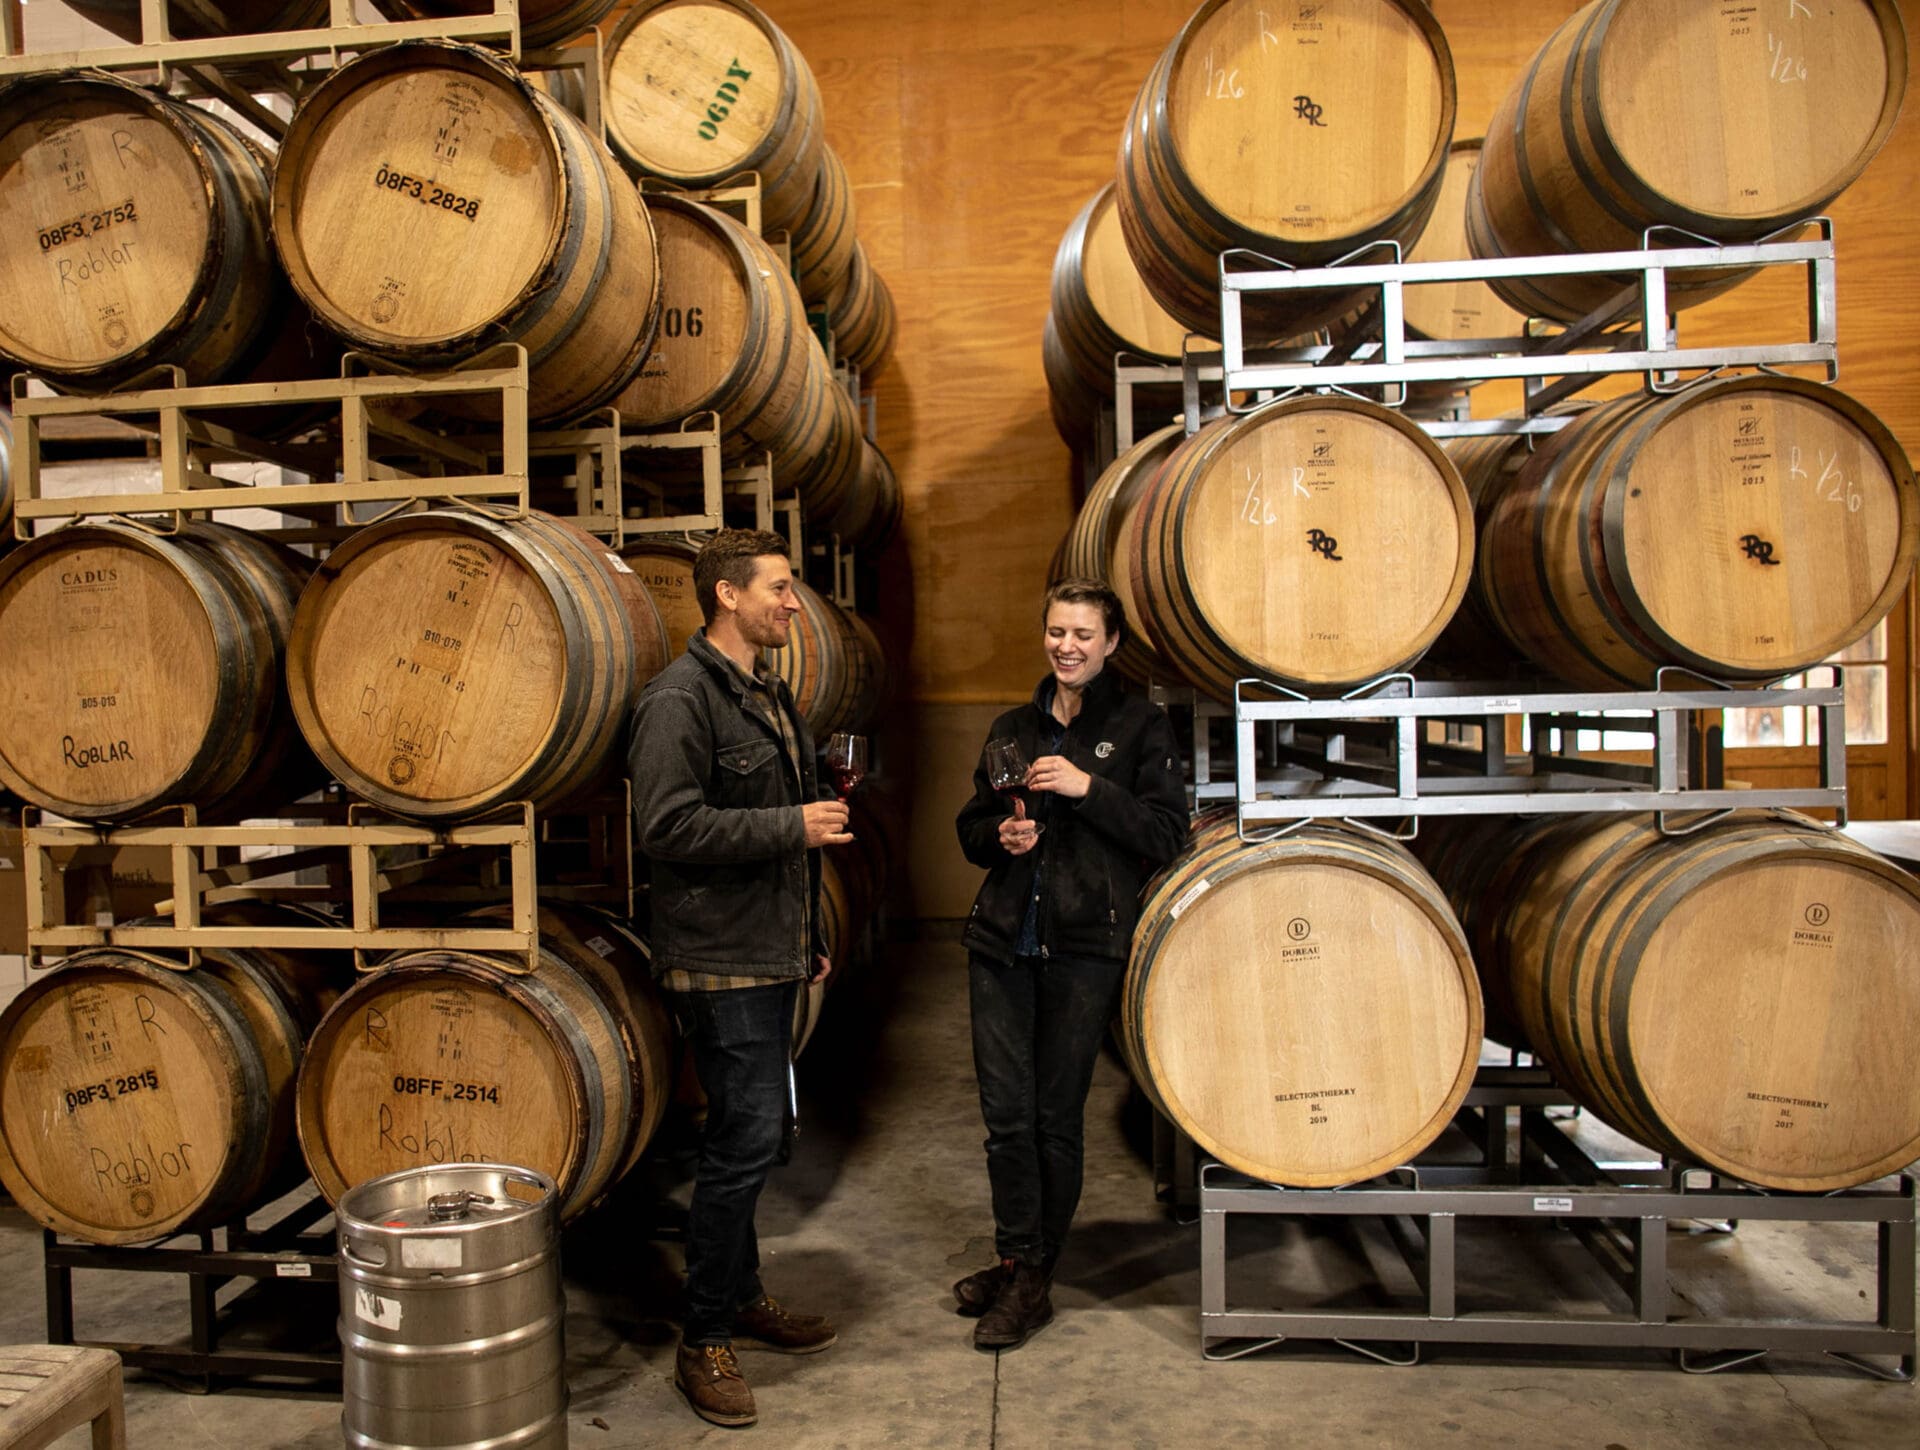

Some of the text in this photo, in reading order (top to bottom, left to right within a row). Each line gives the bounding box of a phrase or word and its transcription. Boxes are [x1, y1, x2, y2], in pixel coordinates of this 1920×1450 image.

[1256, 9, 1278, 54] R
[697, 57, 752, 141] OGDY
[112, 129, 141, 170] R
[1790, 446, 1807, 480] R
[1292, 467, 1310, 498] R
[61, 568, 118, 586] CADUS
[640, 575, 684, 587] ADUS
[497, 602, 523, 653] R
[1282, 946, 1320, 957] DOREAU
[1794, 931, 1834, 943] DOREAU
[135, 994, 167, 1042] R
[366, 1007, 389, 1049] R
[1310, 1116, 1328, 1125] 2019
[1774, 1120, 1794, 1130] 2017
